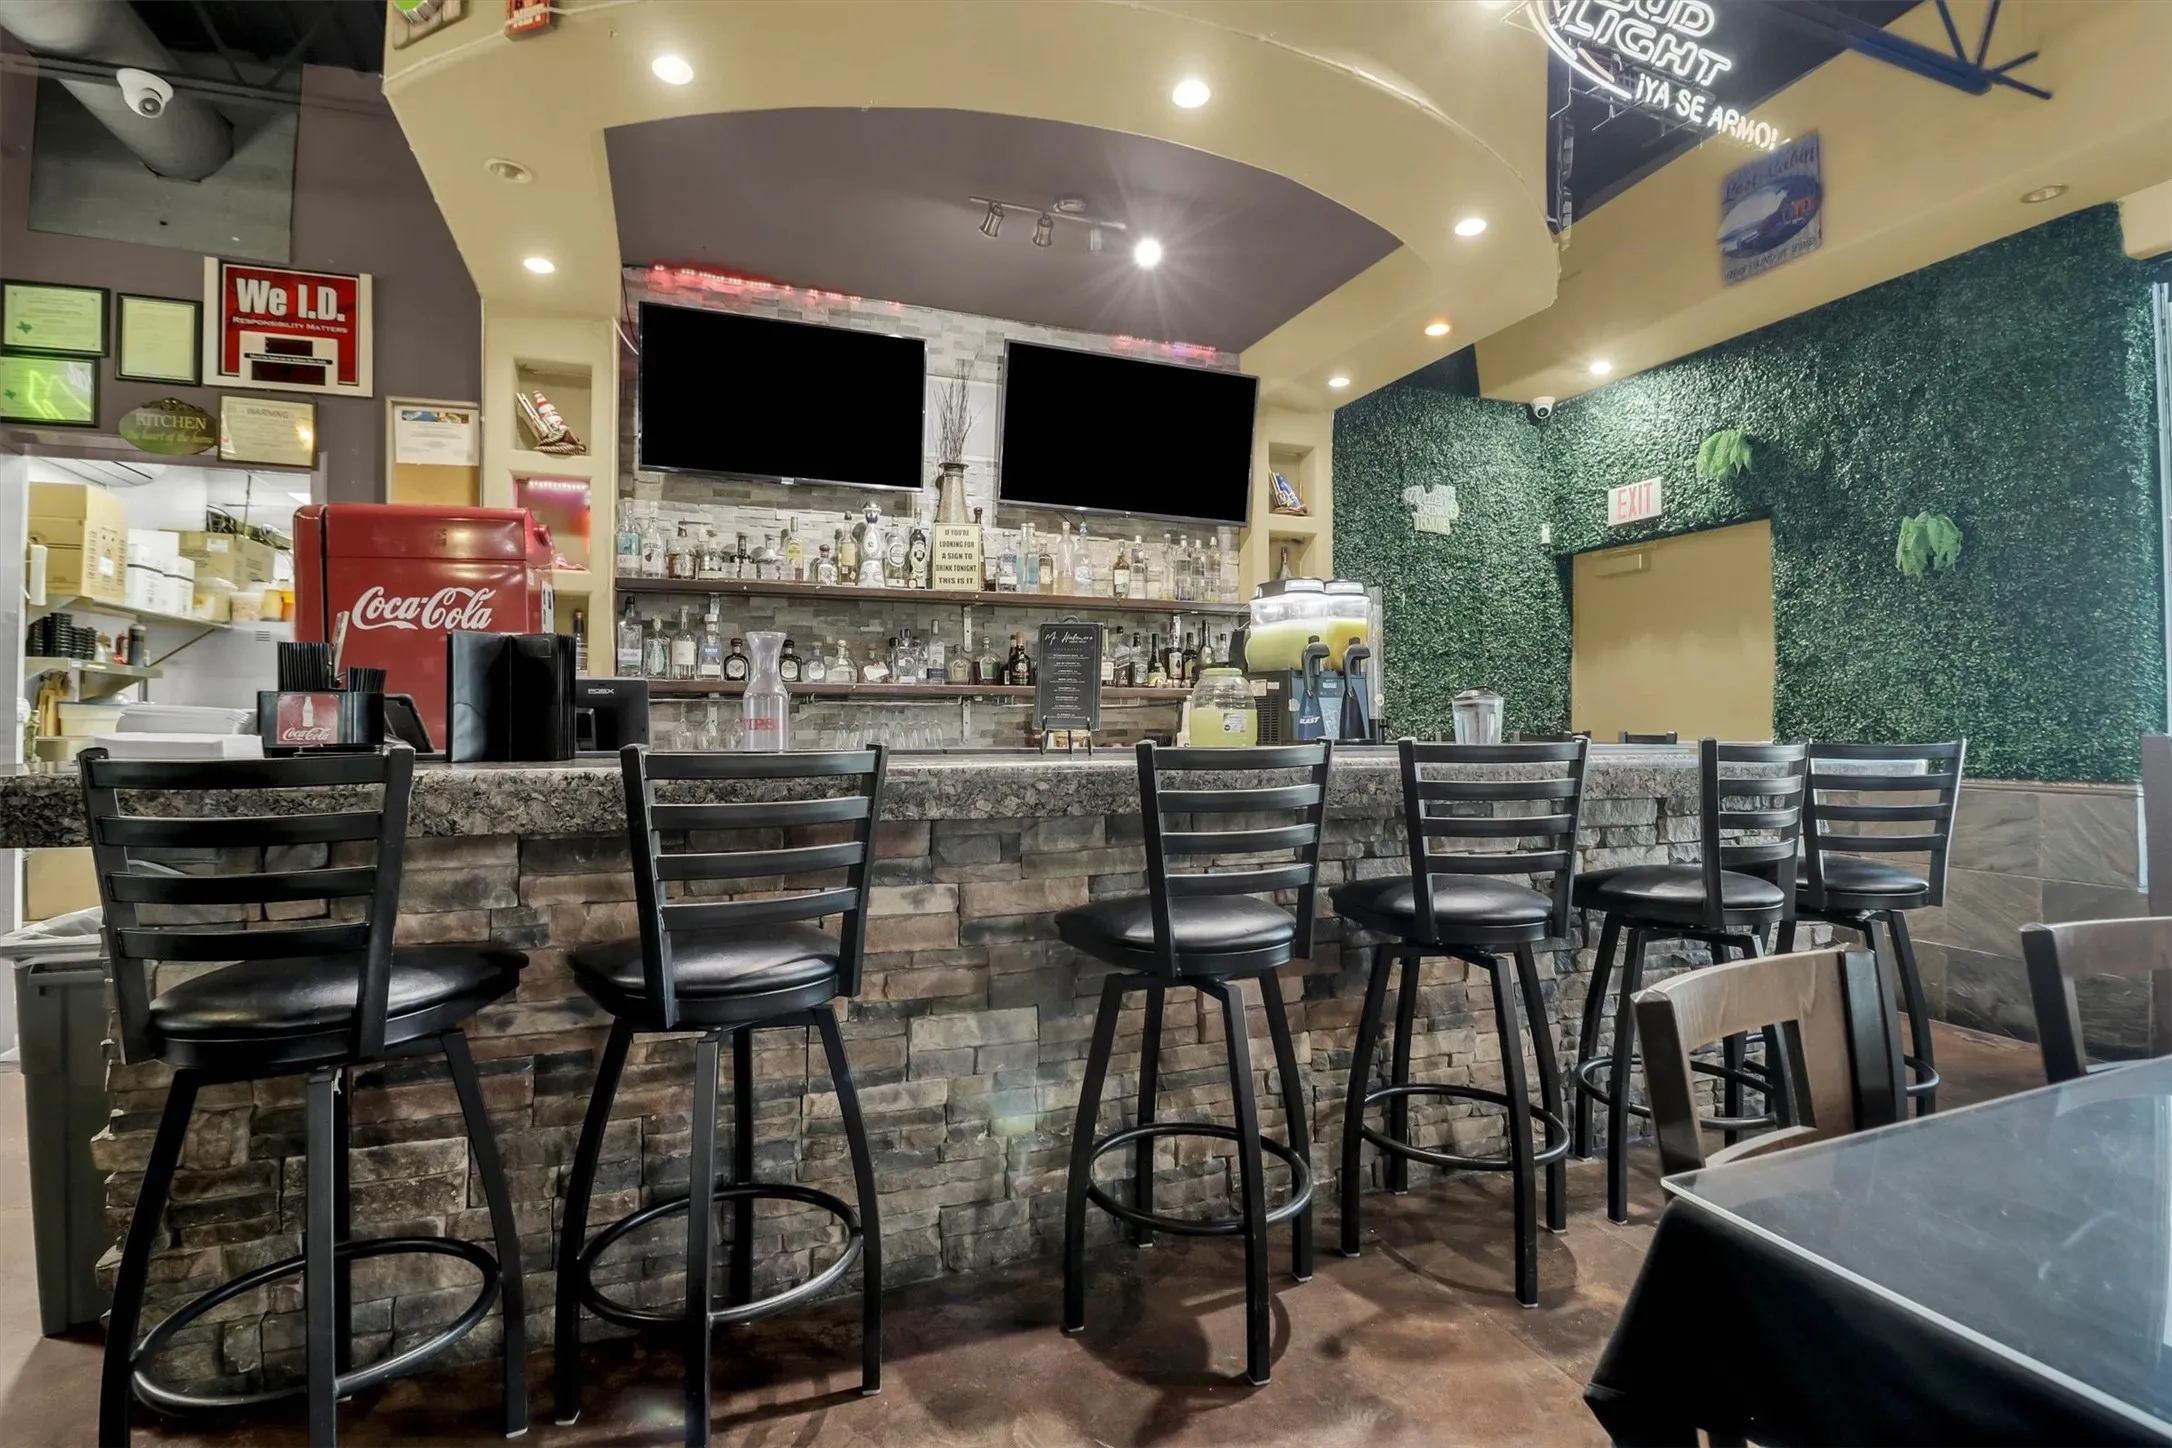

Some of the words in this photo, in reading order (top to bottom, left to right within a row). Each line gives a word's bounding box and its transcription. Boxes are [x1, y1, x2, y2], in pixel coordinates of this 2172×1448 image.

[1560, 0, 1732, 86] LIGHT
[1674, 88, 1708, 123] SE
[236, 277, 288, 317] We
[297, 283, 346, 322] I.D.
[232, 316, 305, 329] RESPONSIBILITY
[306, 323, 349, 334] MATTERS
[135, 413, 208, 430] KITCHEN
[247, 407, 290, 419] WARNING
[1617, 482, 1653, 520] EXIT
[942, 552, 946, 560] A
[947, 552, 963, 560] SIGN
[965, 552, 973, 560] TO
[351, 586, 497, 631] Coca-Cola
[282, 727, 332, 742] Coca-Cola
